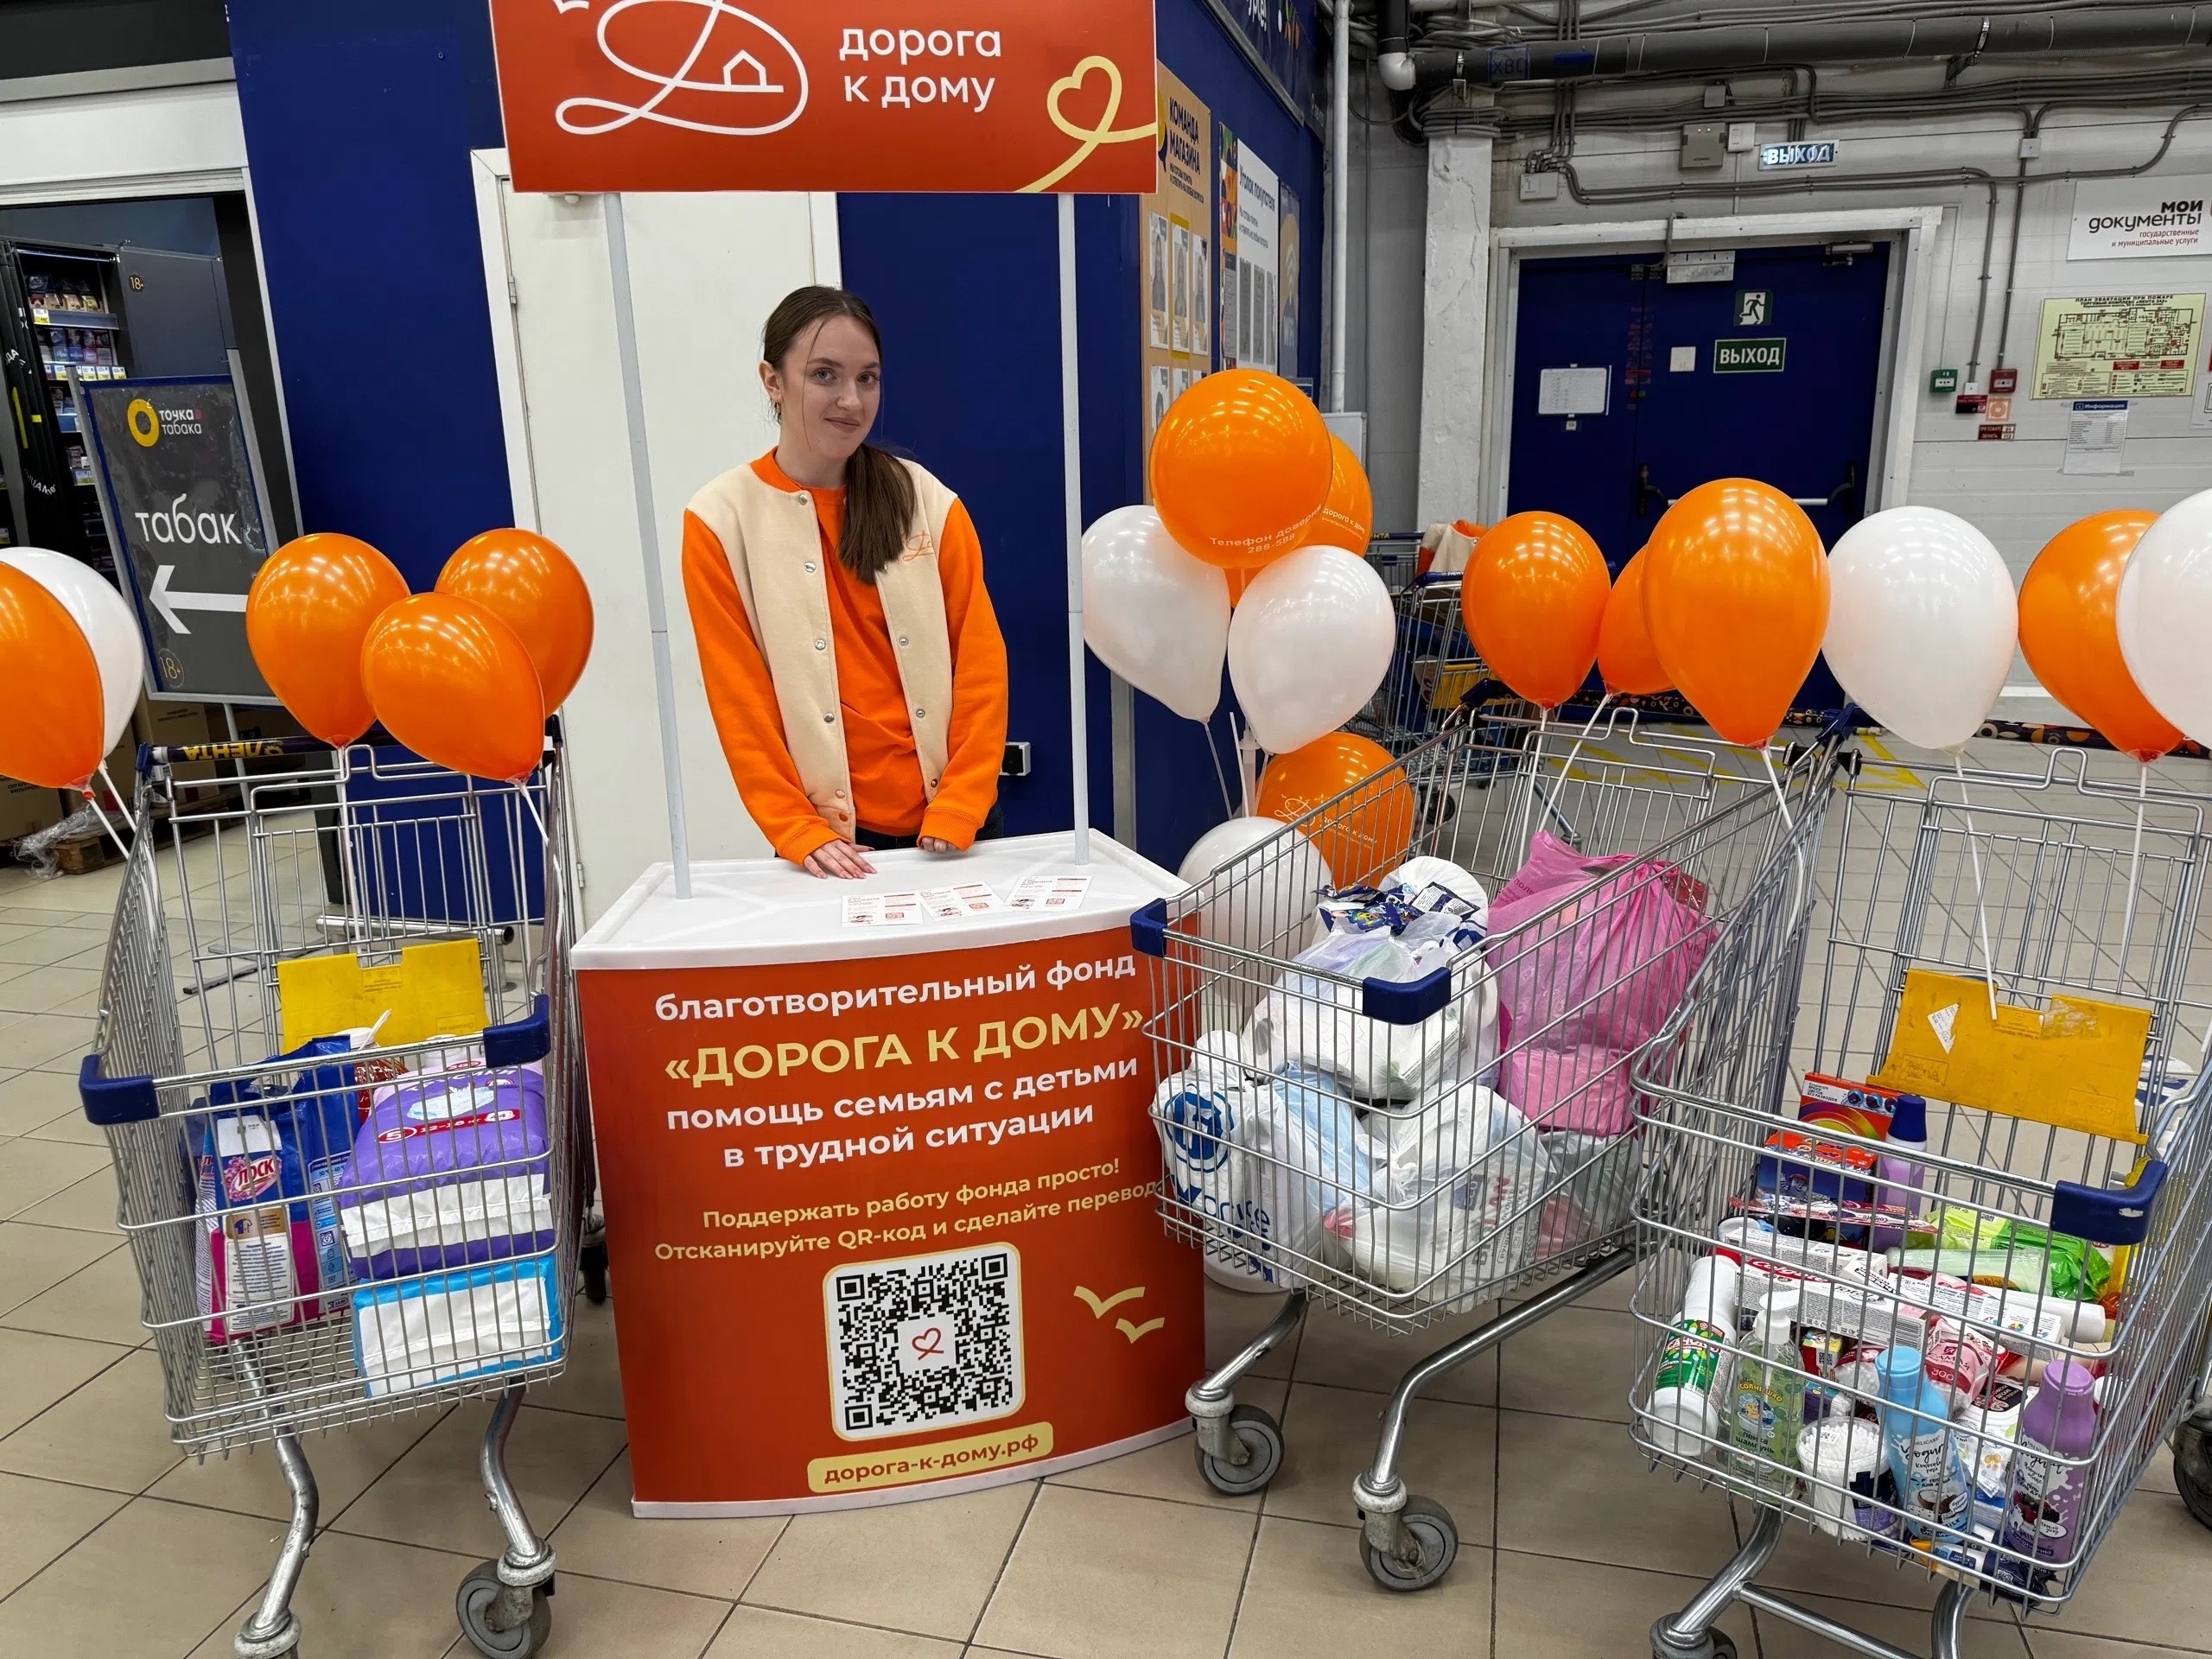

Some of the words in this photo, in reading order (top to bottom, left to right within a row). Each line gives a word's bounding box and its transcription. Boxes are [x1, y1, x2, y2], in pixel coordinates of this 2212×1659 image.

[839, 27, 1002, 64] дорога
[843, 73, 870, 103] к
[881, 74, 996, 113] дому
[1169, 96, 1199, 145] КОМАНДА
[1169, 130, 1201, 175] МАГАЗИНА
[1765, 145, 1830, 165] ВЫХОД
[2088, 213, 2202, 233] документы
[2139, 228, 2200, 238] государственные
[2118, 238, 2174, 248] муниципальные
[2175, 237, 2198, 246] услуги
[1719, 346, 1780, 365] ВЫХОД
[159, 409, 194, 422] точка
[162, 419, 202, 435] табака
[135, 493, 243, 544] табак
[1323, 507, 1350, 523] дорога
[1210, 534, 1272, 548] Телефон
[1247, 533, 1296, 554] 288-588
[160, 656, 181, 679] 18+
[182, 741, 263, 760] ЛЕНТА
[655, 963, 1036, 1023] благотворительный
[1046, 953, 1136, 993] фонд
[664, 1033, 912, 1089] «ДОРОГА
[928, 1027, 959, 1063] К
[973, 1002, 1144, 1065] ДОМУ»
[667, 1100, 824, 1131] помощь
[834, 1082, 973, 1118] семьям
[984, 1079, 1004, 1101] с
[1013, 1058, 1139, 1100] детьми
[385, 1131, 402, 1141] 5
[724, 1145, 745, 1168] в
[754, 1125, 915, 1171] трудной
[925, 1103, 1095, 1149] ситуации
[238, 1158, 275, 1186] ЛОСК
[702, 1202, 860, 1232] Поддержать
[867, 1188, 950, 1219] работу
[956, 1176, 1032, 1207] фонда
[1037, 1157, 1120, 1191] просто!
[655, 1233, 831, 1263] Отсканируйте
[837, 1223, 927, 1250] QR-код
[933, 1222, 947, 1236] и
[954, 1201, 1062, 1235] сделайте
[1931, 1368, 1955, 1381] 300
[823, 1433, 1039, 1485] дорога-к-дому.рф
